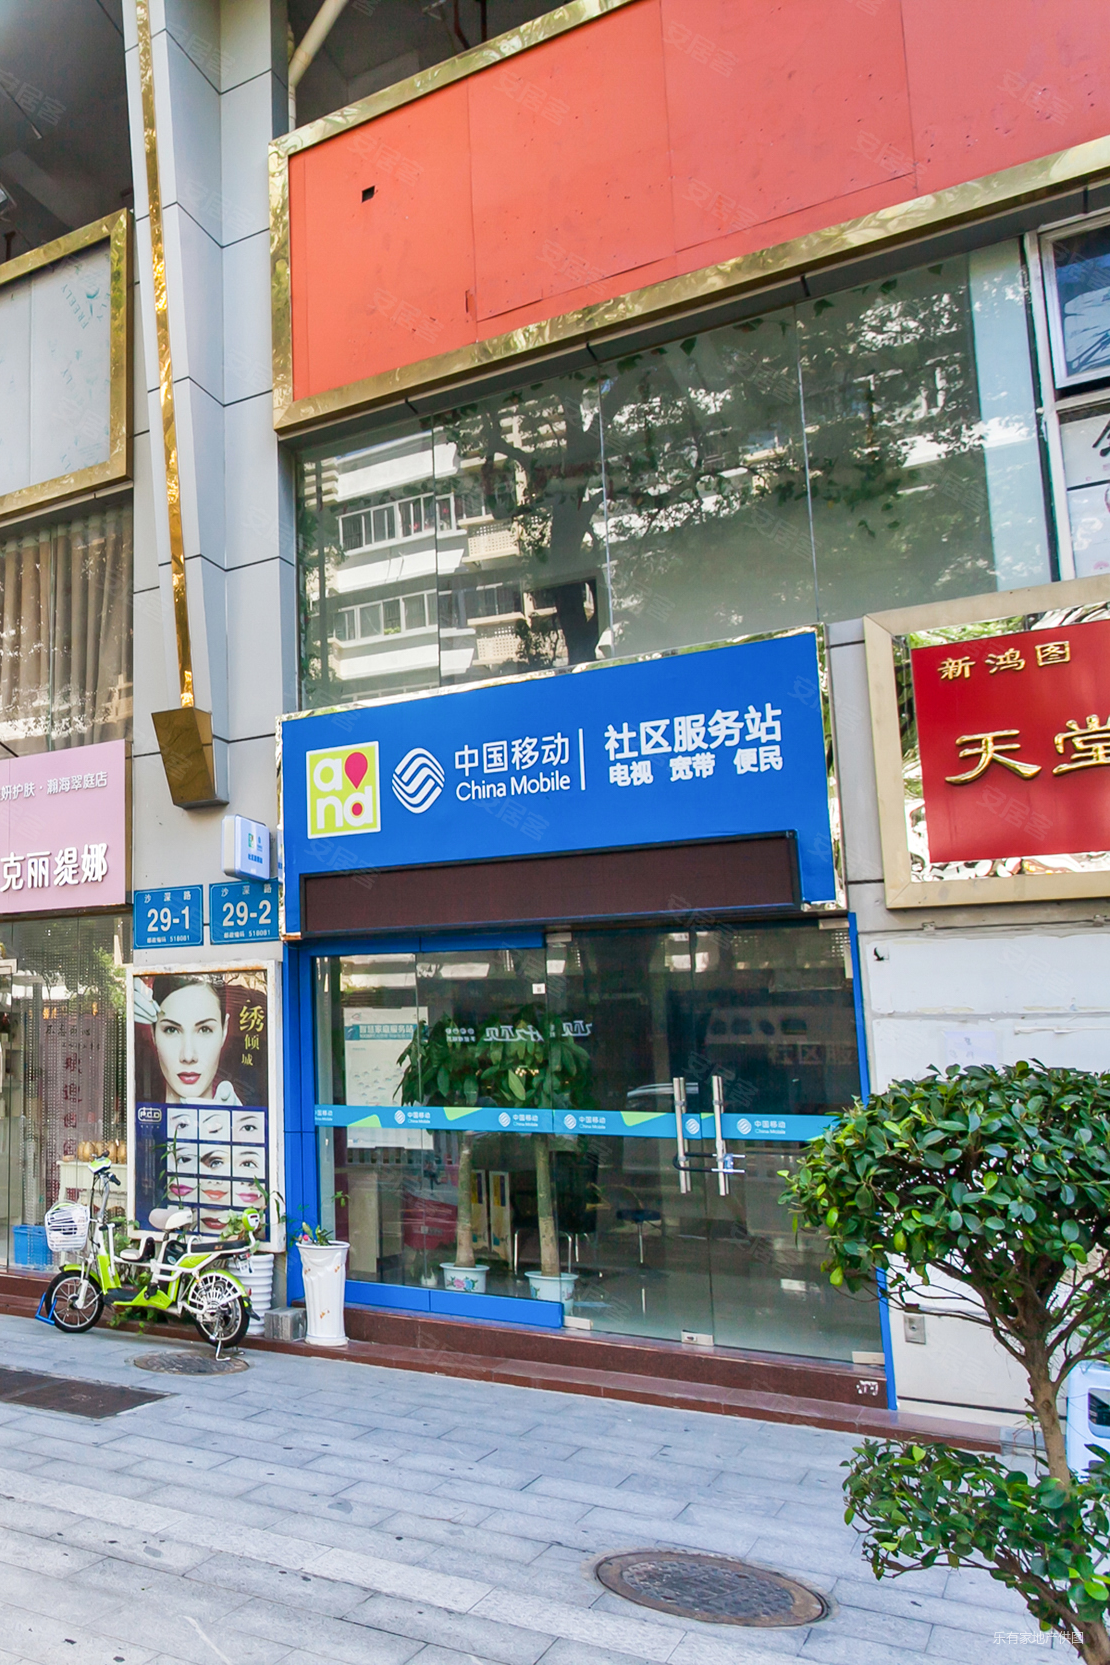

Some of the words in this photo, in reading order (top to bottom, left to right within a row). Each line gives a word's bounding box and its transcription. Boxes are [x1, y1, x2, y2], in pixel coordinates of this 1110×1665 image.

[938, 641, 1070, 680] 新鸿图
[605, 703, 783, 761] 社区服务站
[945, 714, 1110, 785] 天堂
[454, 732, 571, 778] 中国移动
[608, 760, 653, 788] 电视
[669, 752, 716, 783] 宽带
[733, 745, 784, 775] 便民
[47, 771, 108, 795] 瀚海翠庭店
[455, 778, 506, 802] China
[510, 771, 571, 797] Mobile
[0, 843, 109, 893] 克丽缇娜
[147, 905, 190, 932] 29-1
[222, 900, 272, 926] 29-2
[754, 1120, 786, 1129] 中国移动
